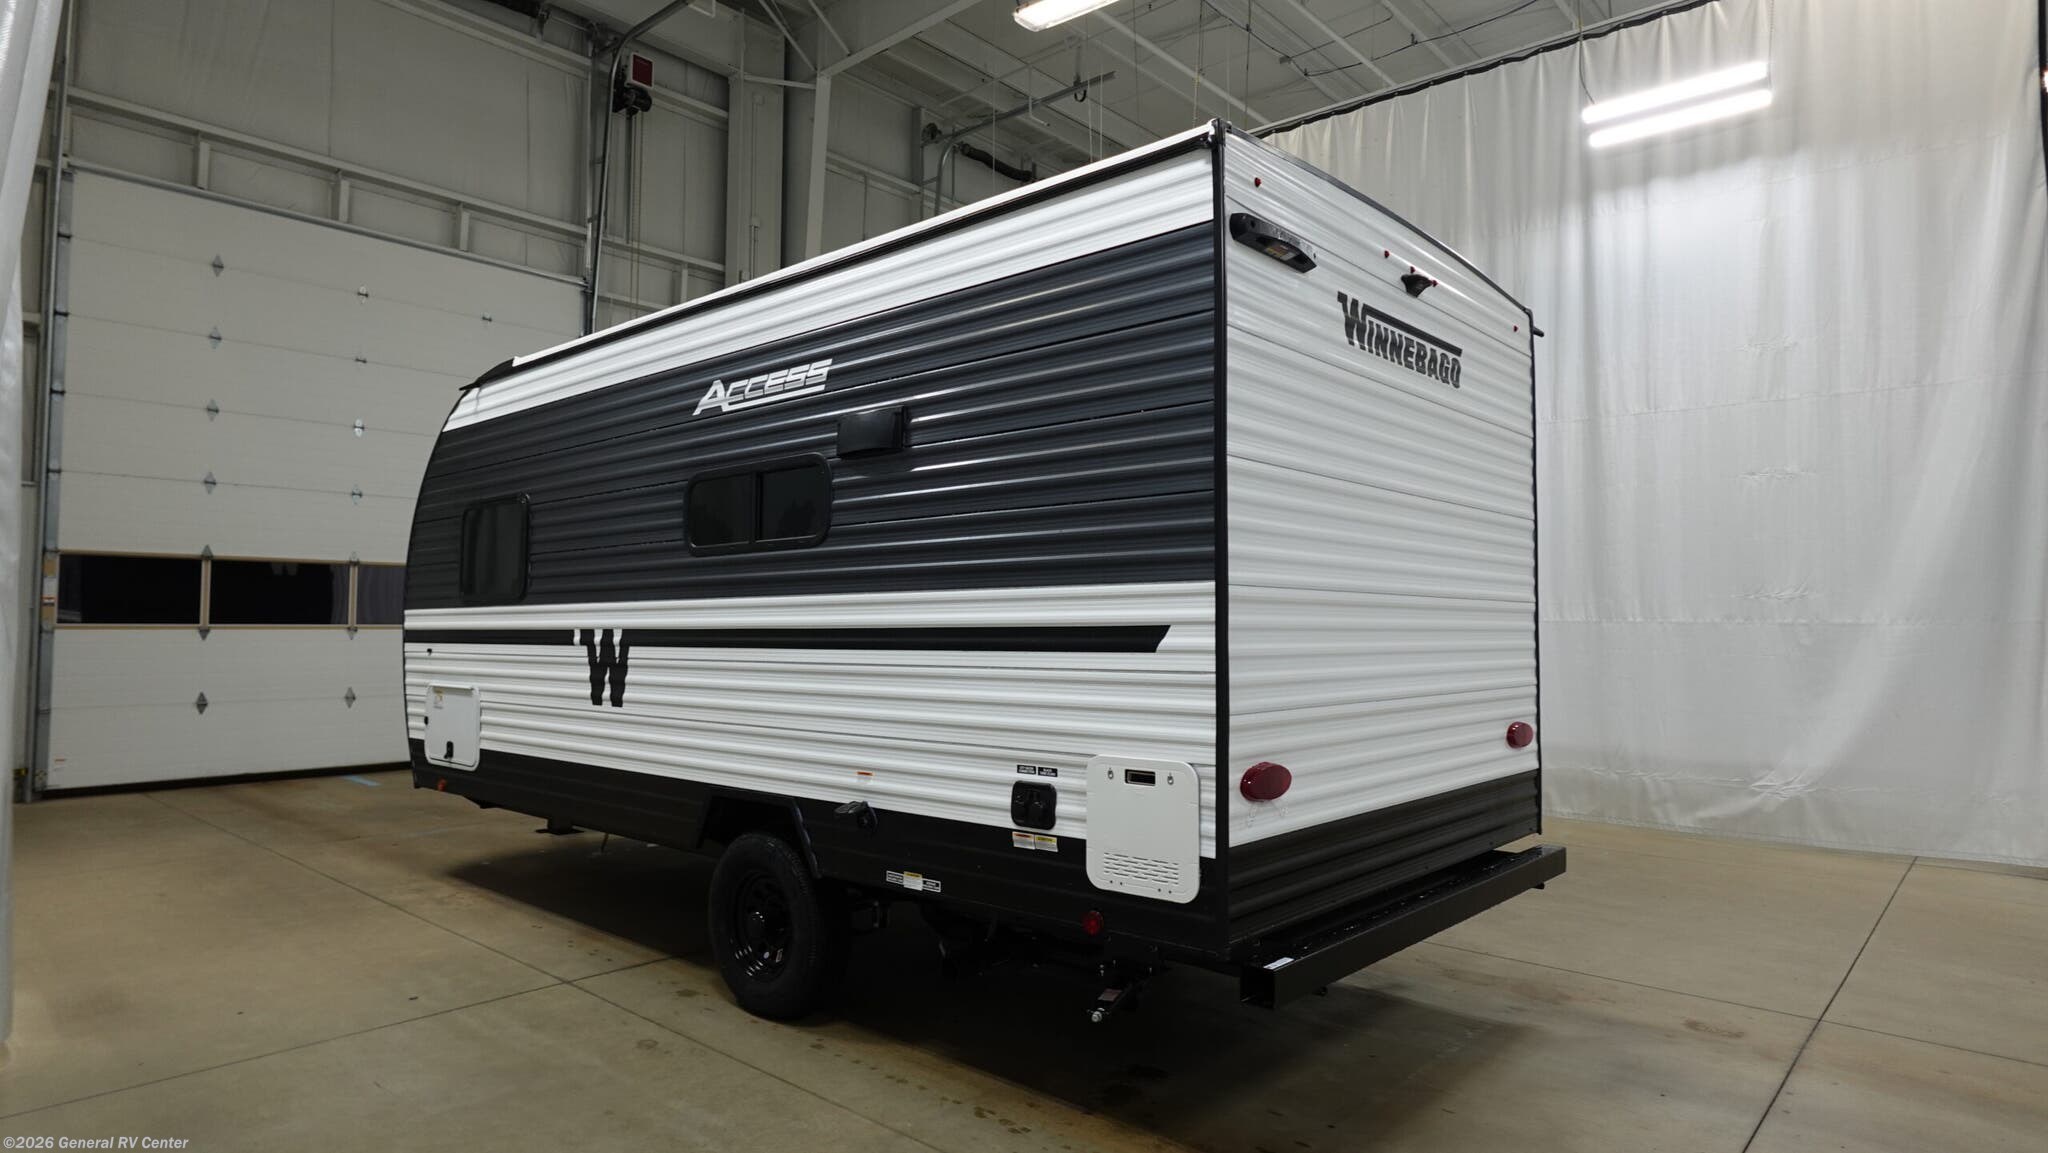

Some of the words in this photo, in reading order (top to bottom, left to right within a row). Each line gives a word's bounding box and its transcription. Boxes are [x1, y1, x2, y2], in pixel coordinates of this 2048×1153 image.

[1337, 290, 1463, 389] WINNEBAGO
[692, 358, 833, 416] ACCESS
[580, 628, 630, 708] W
